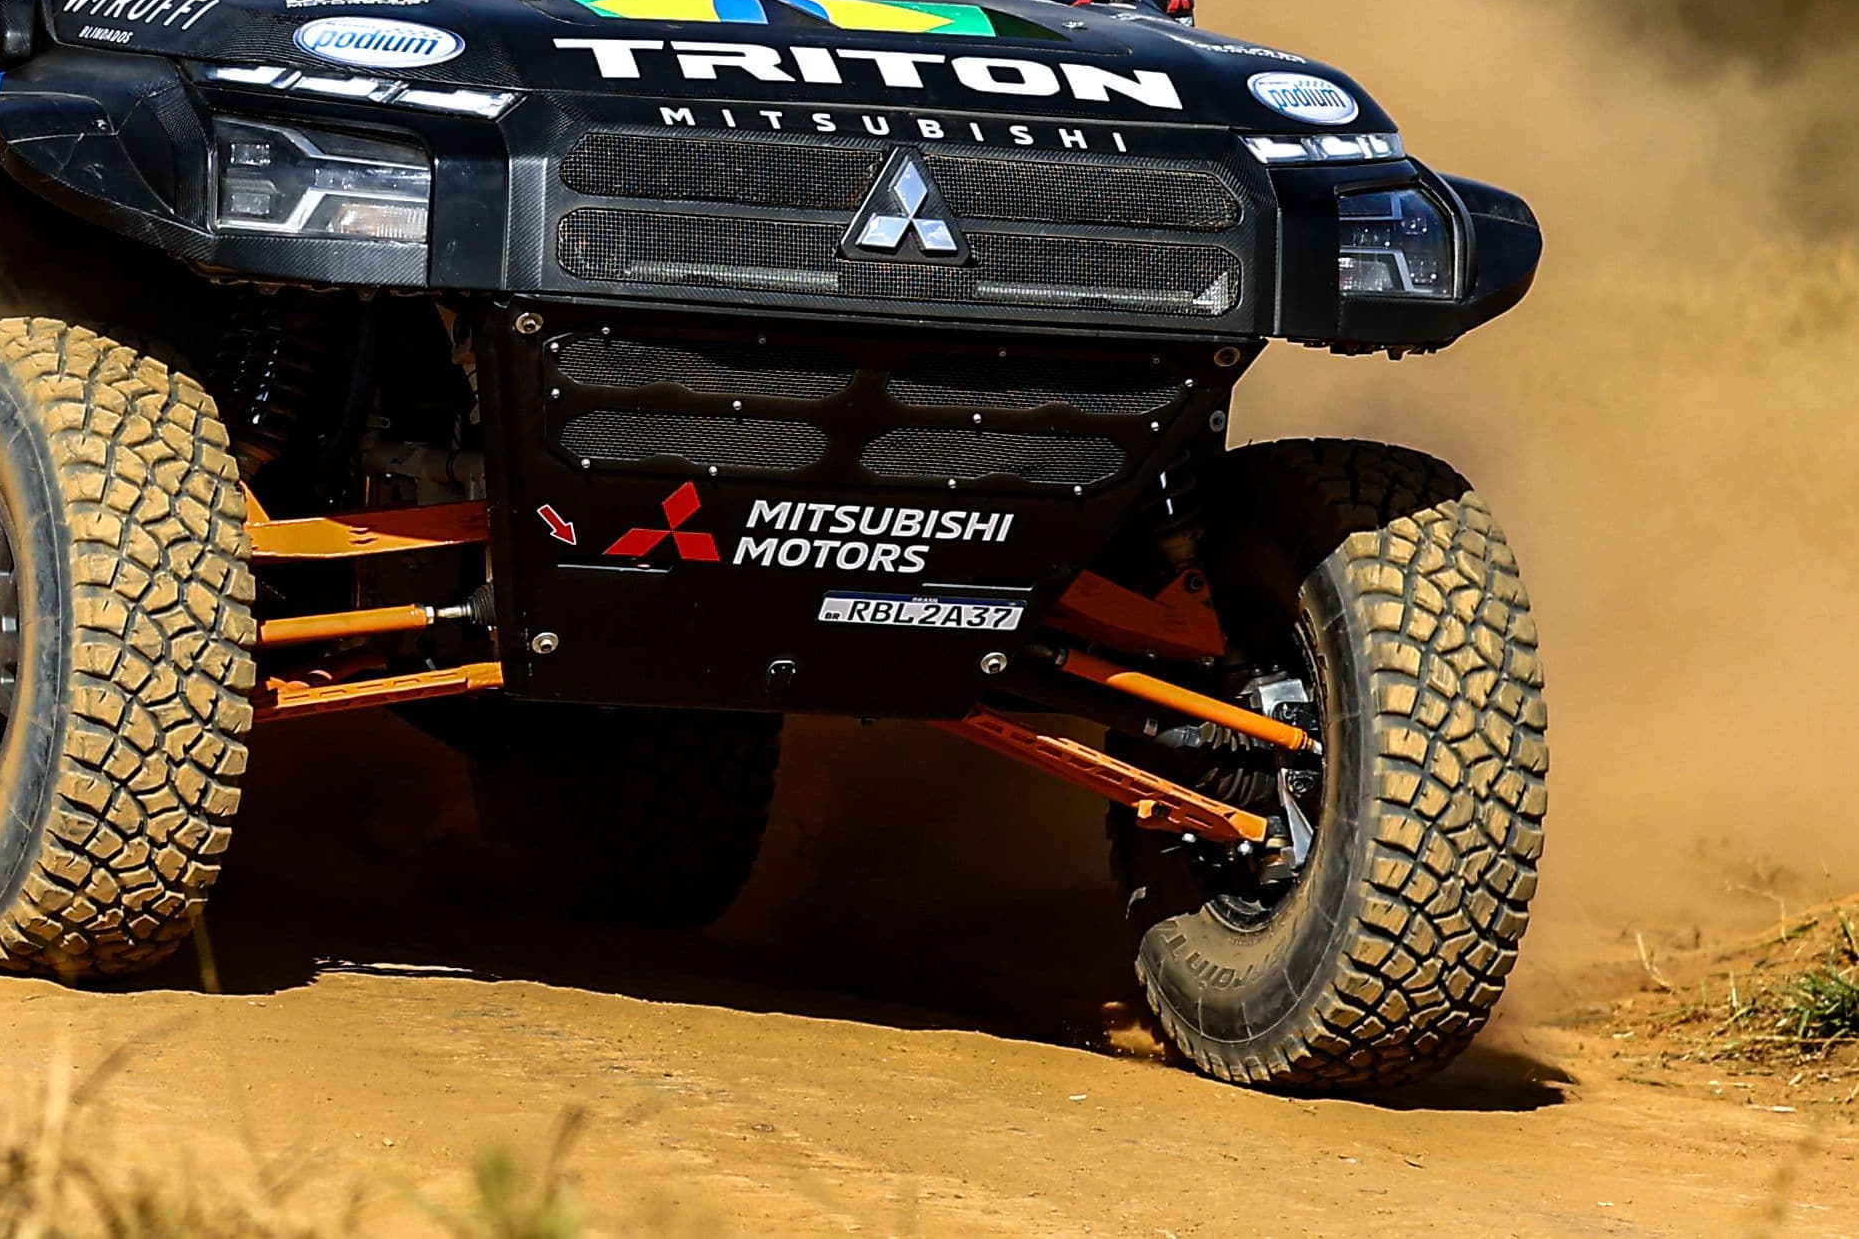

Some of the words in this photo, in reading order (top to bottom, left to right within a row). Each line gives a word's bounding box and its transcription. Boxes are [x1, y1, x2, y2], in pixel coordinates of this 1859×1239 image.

[78, 25, 134, 44] BLINDADOS
[310, 27, 440, 58] podium
[553, 38, 1184, 110] TRITON
[1267, 82, 1348, 112] podium
[659, 106, 1128, 154] MITSUBISHI
[746, 500, 1014, 542] MITSUBISHI
[732, 536, 930, 573] MOTORS
[847, 600, 1013, 629] RBL2A37
